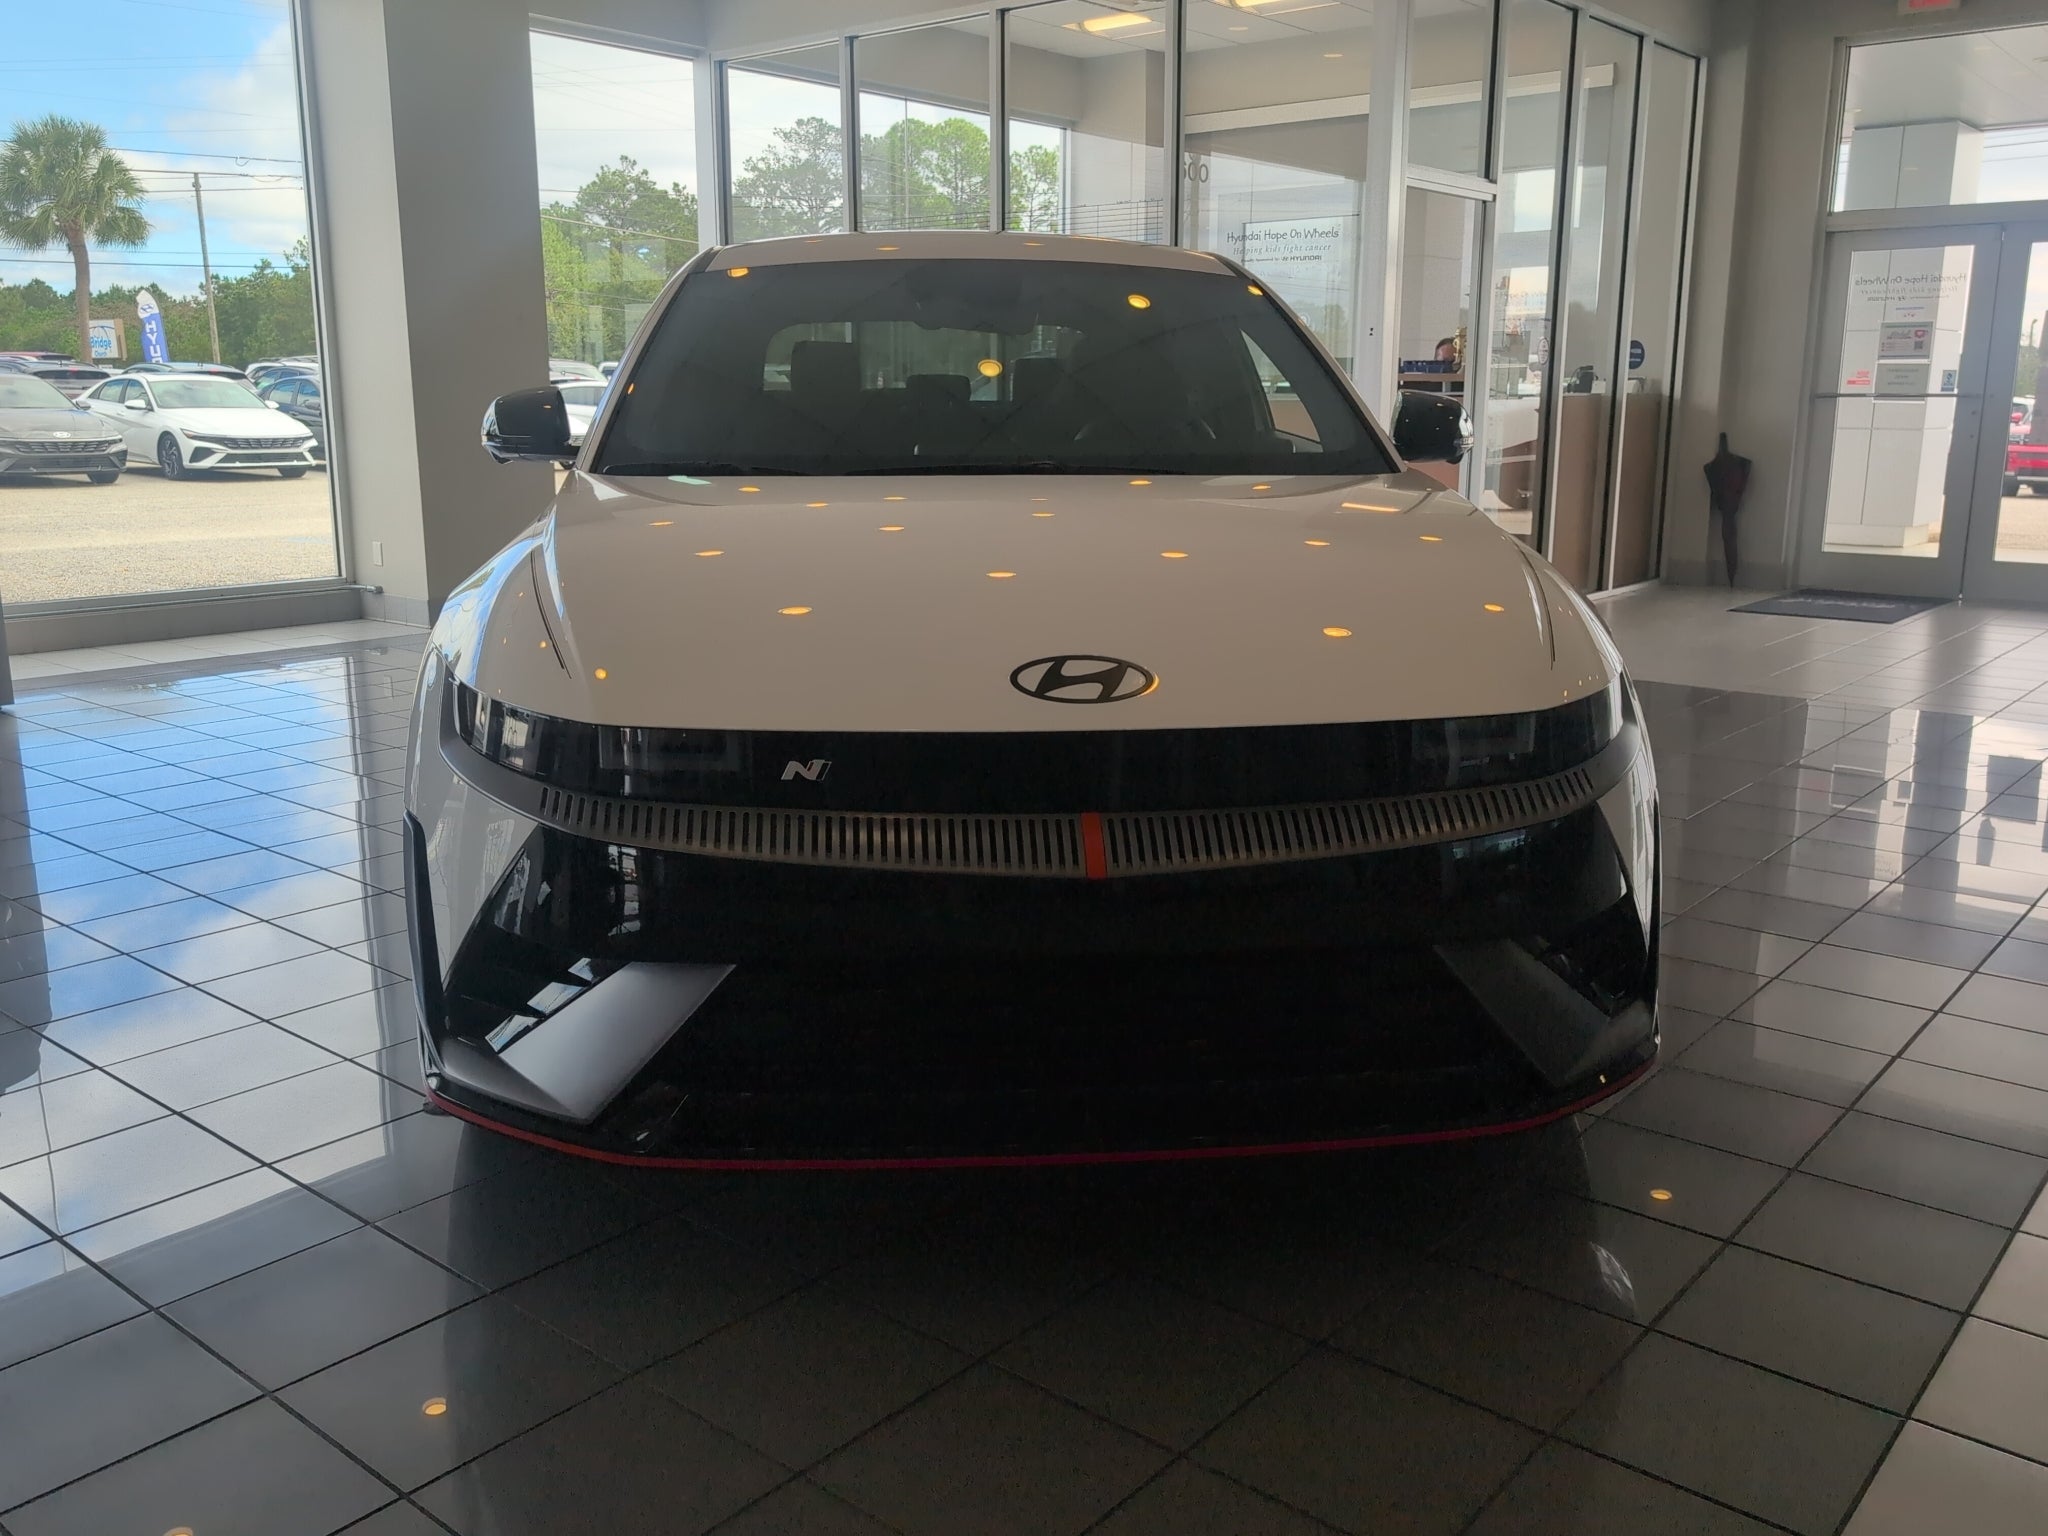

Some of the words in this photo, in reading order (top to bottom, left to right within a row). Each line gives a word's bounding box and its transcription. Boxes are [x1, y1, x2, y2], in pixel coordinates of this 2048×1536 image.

[1184, 161, 1209, 183] 00
[1226, 230, 1262, 245] Hyundai
[1264, 228, 1288, 243] Hope
[1290, 228, 1302, 239] On
[1303, 226, 1340, 239] Wheels
